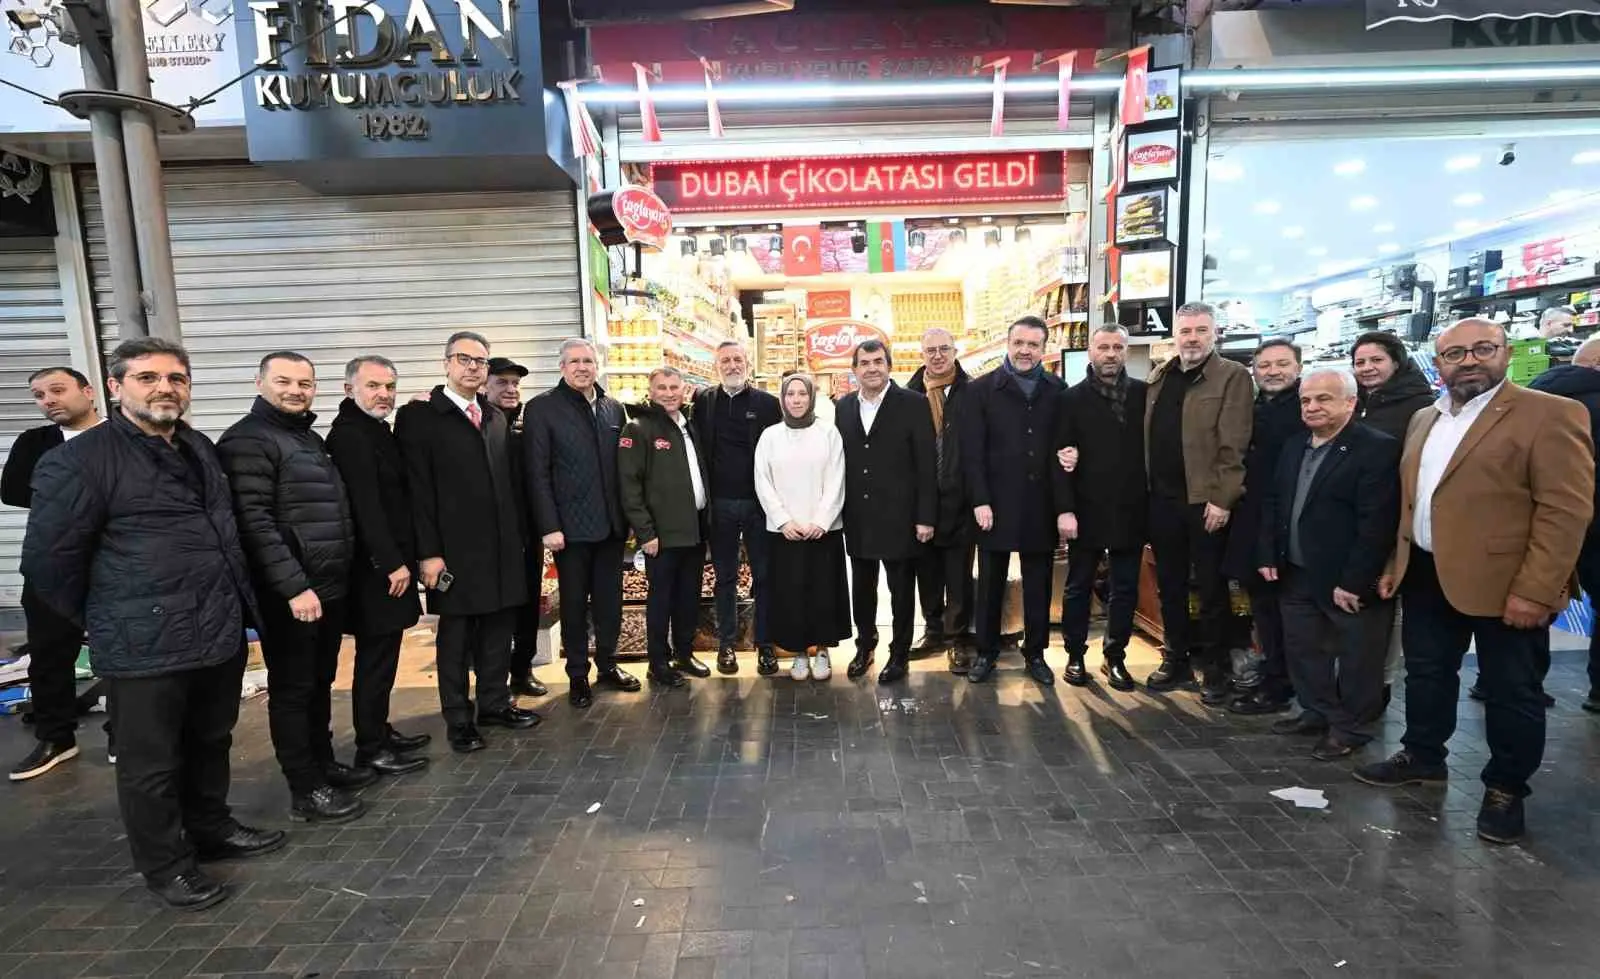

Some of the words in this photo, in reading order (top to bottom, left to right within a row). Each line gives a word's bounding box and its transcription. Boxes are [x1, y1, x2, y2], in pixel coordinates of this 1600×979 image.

[254, 69, 523, 111] KUYUMCULUK
[359, 111, 428, 139] 1982
[680, 164, 770, 198] DUBAİ
[779, 162, 944, 201] ÇİKOLATASI
[953, 155, 1036, 189] GELDİ
